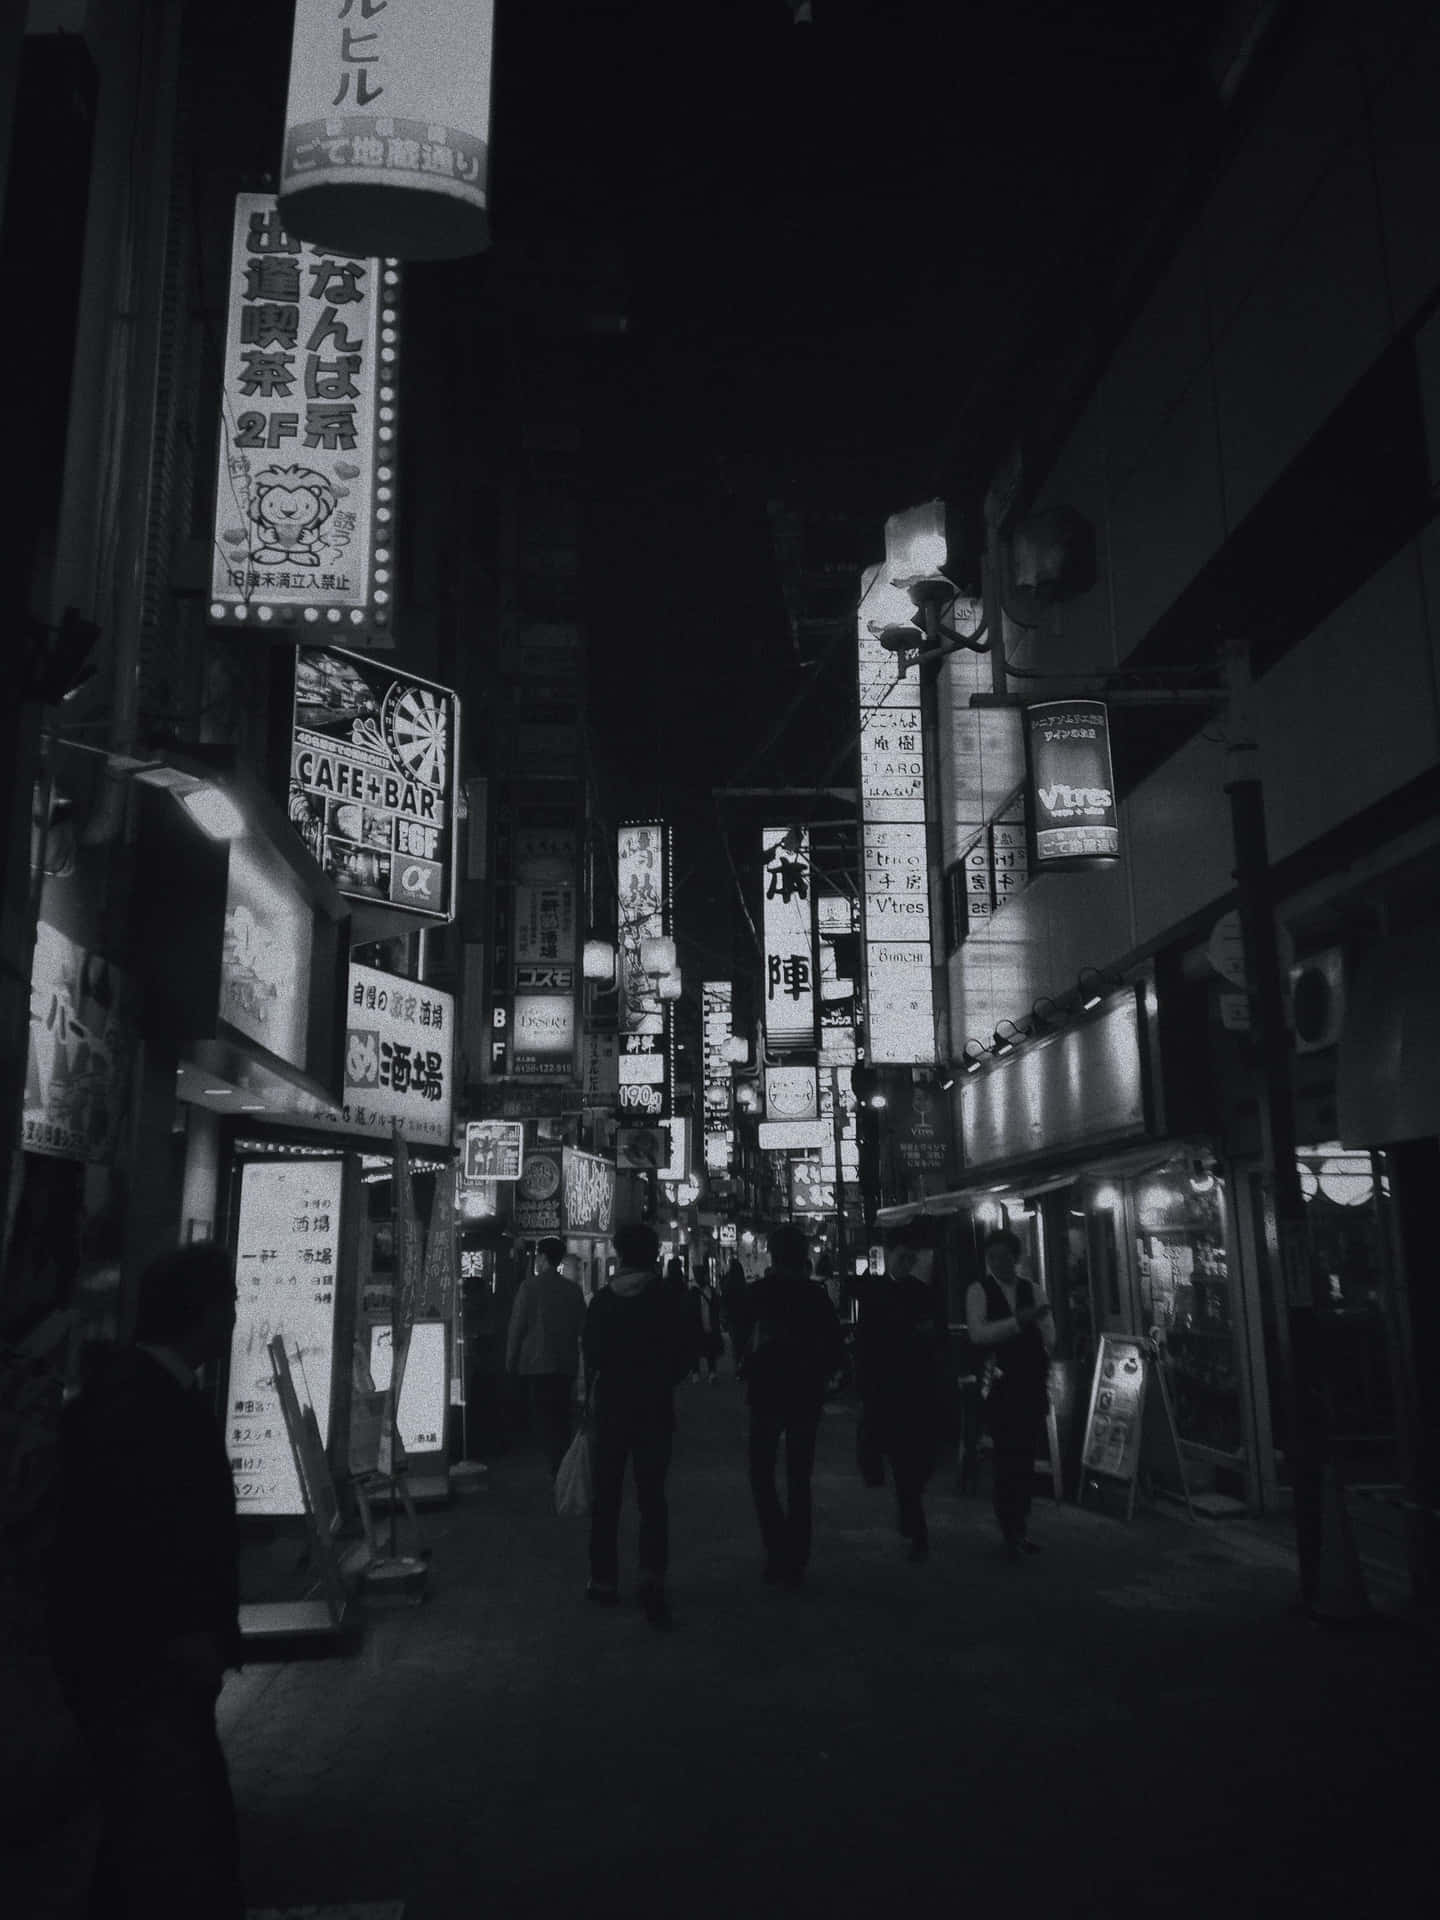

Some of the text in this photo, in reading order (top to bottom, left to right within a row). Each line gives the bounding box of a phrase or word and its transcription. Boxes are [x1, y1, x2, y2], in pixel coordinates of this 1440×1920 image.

[235, 411, 300, 448] 2F
[226, 569, 350, 591] 18歳未満立入禁止
[873, 762, 921, 775] TARO
[296, 750, 436, 821] CAFE+BAR
[877, 897, 925, 914] V'tres
[519, 968, 572, 987] コスモ
[354, 981, 443, 1031] 自慢の激安酒場
